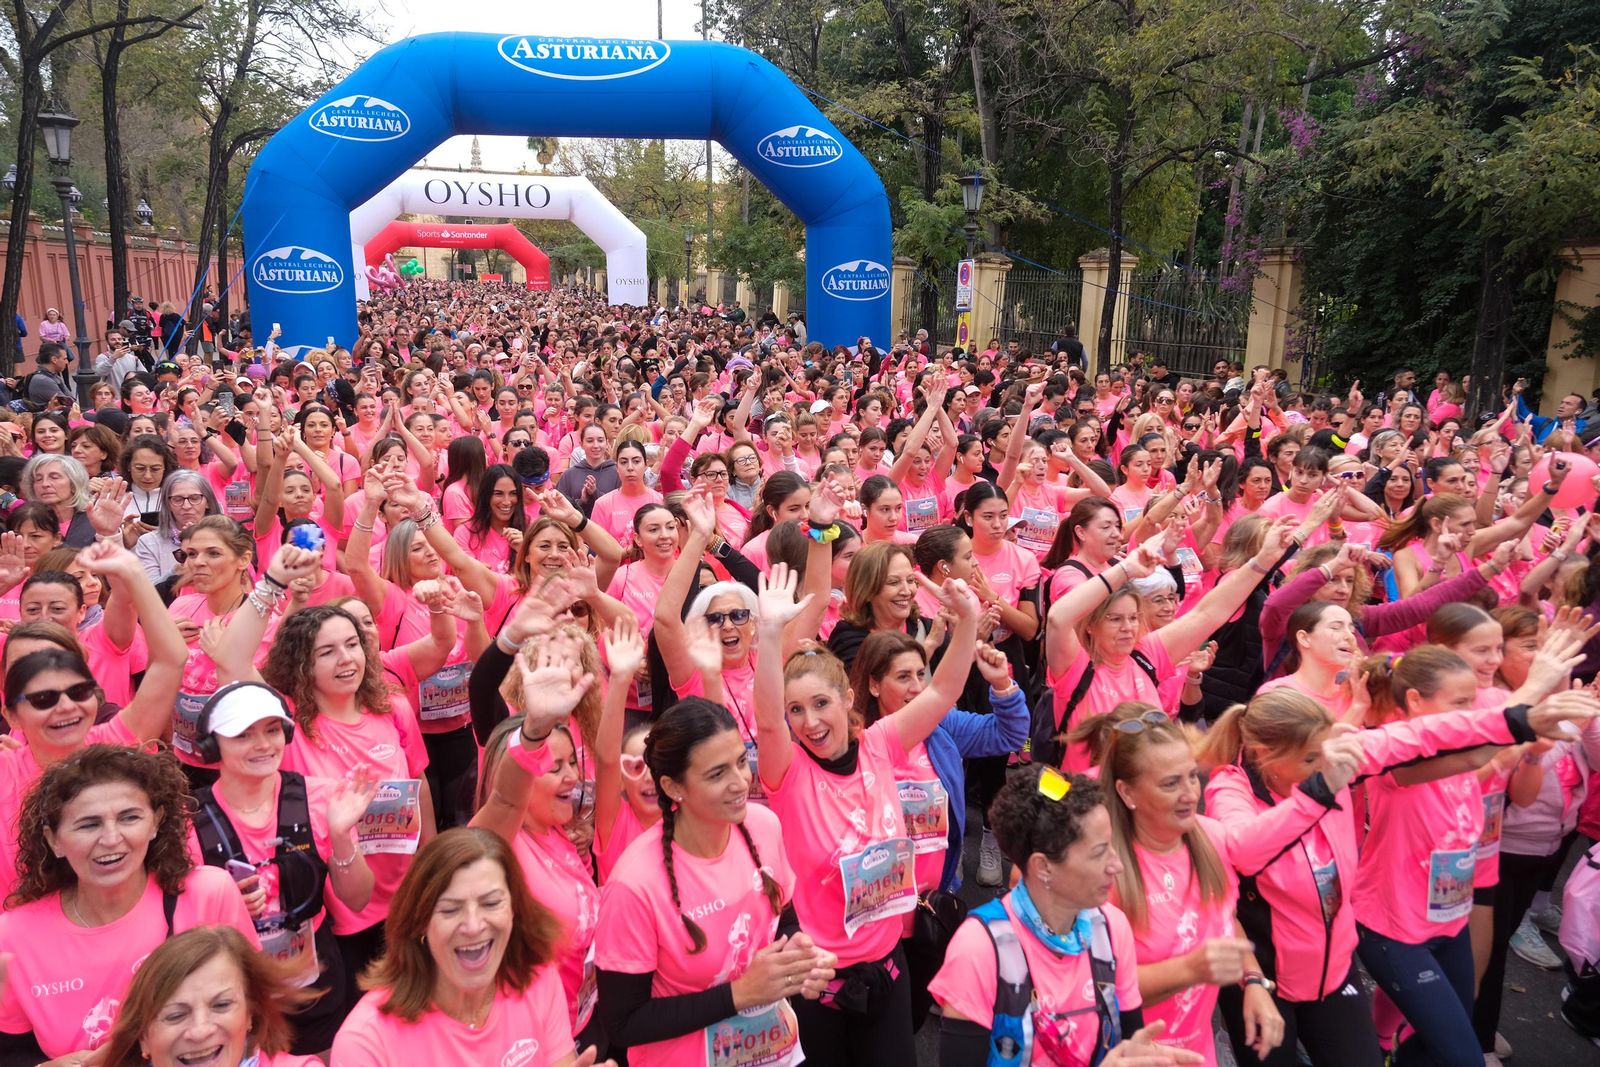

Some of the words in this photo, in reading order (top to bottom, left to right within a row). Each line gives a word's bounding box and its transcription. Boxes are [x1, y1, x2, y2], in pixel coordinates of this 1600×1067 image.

[511, 38, 659, 60] ASTURIANA
[537, 37, 593, 45] CENTRAL
[315, 111, 403, 133] ASTURIANA
[366, 111, 400, 119] LECHERA
[765, 141, 839, 158] ASTURIANA
[424, 178, 551, 209] OYSHO
[417, 229, 440, 240] Sports
[451, 230, 488, 241] Santander
[257, 262, 339, 283] ASTURIANA
[615, 277, 646, 287] OYSHO
[827, 274, 888, 292] ASTURIANA
[364, 812, 397, 825] 016
[868, 876, 891, 897] 016
[686, 898, 726, 920] YSHO
[31, 978, 84, 998] OYSHO
[743, 1024, 781, 1050] 016
